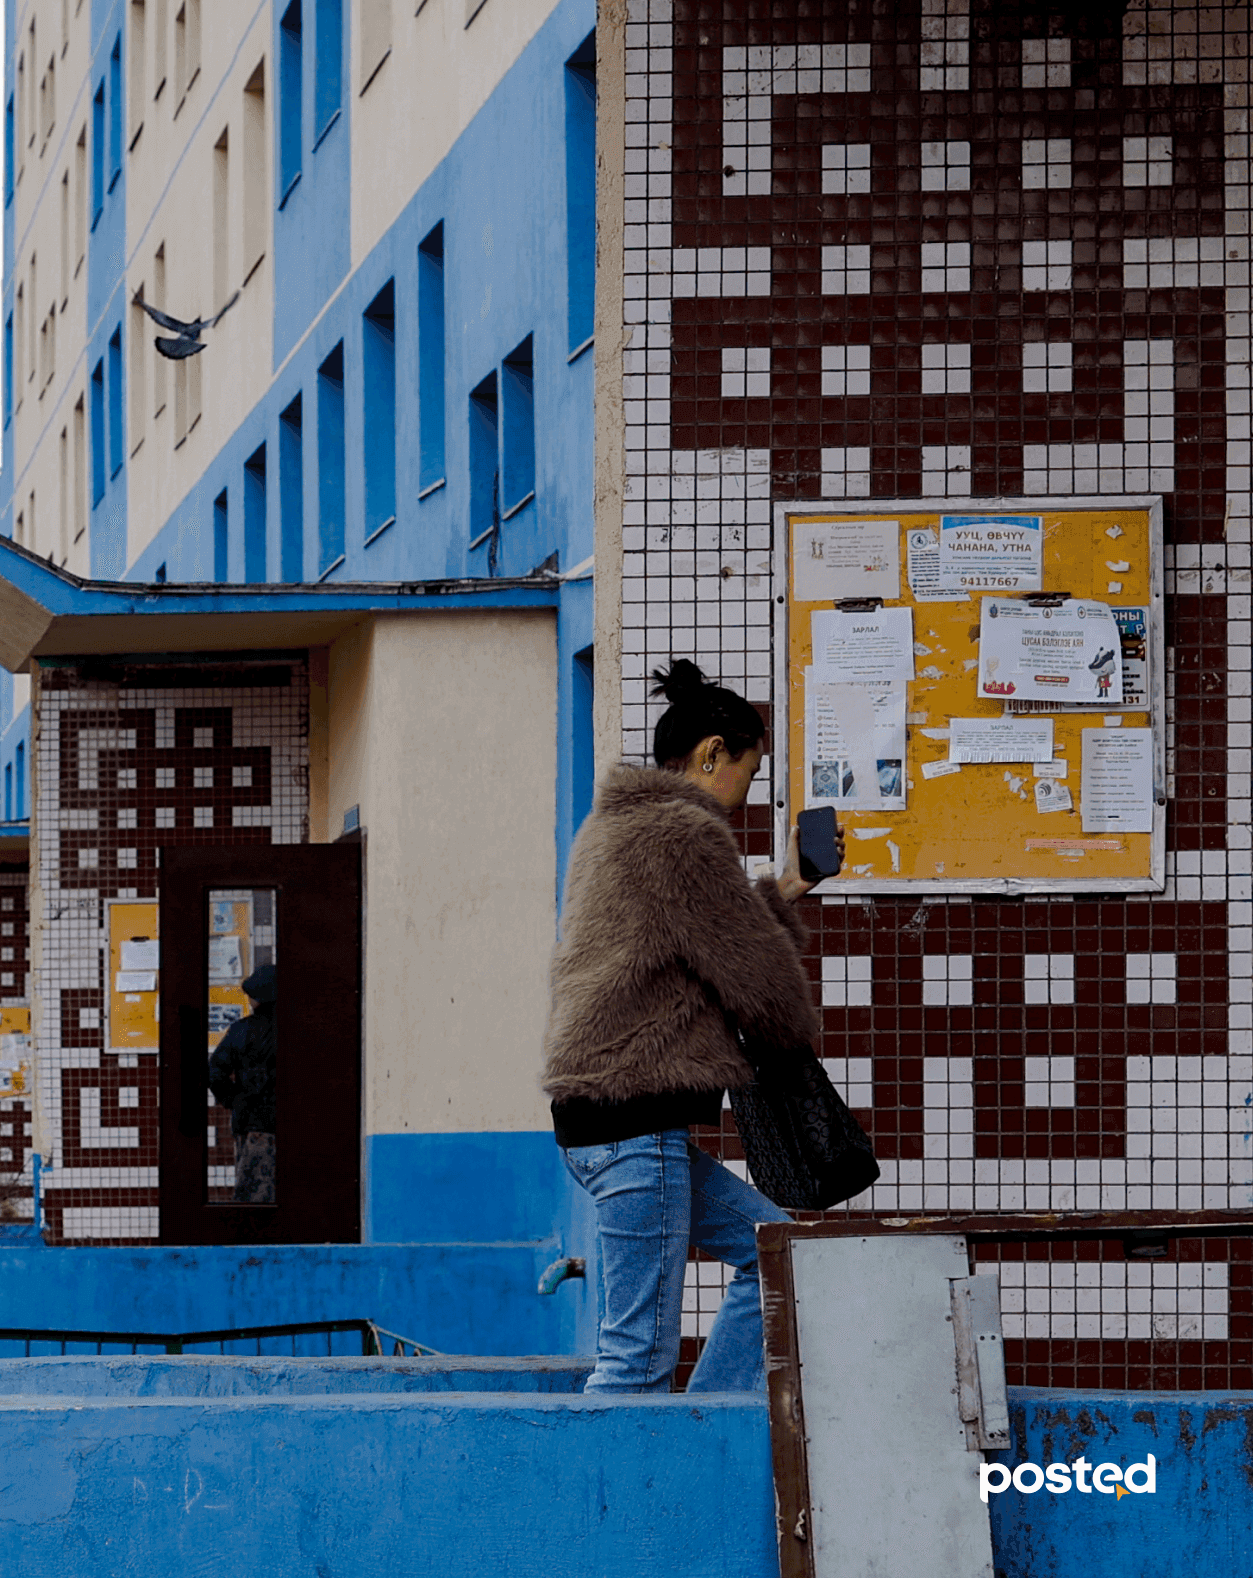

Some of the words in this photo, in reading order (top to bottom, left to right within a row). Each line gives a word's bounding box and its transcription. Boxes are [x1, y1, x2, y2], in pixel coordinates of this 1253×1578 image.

[956, 531, 983, 541] УУЦ,
[987, 531, 1025, 540] ӨВЧҮҮ
[948, 543, 998, 553] ЧАНАНА,
[1002, 543, 1032, 552] УТНА
[960, 577, 1019, 586] 94117667
